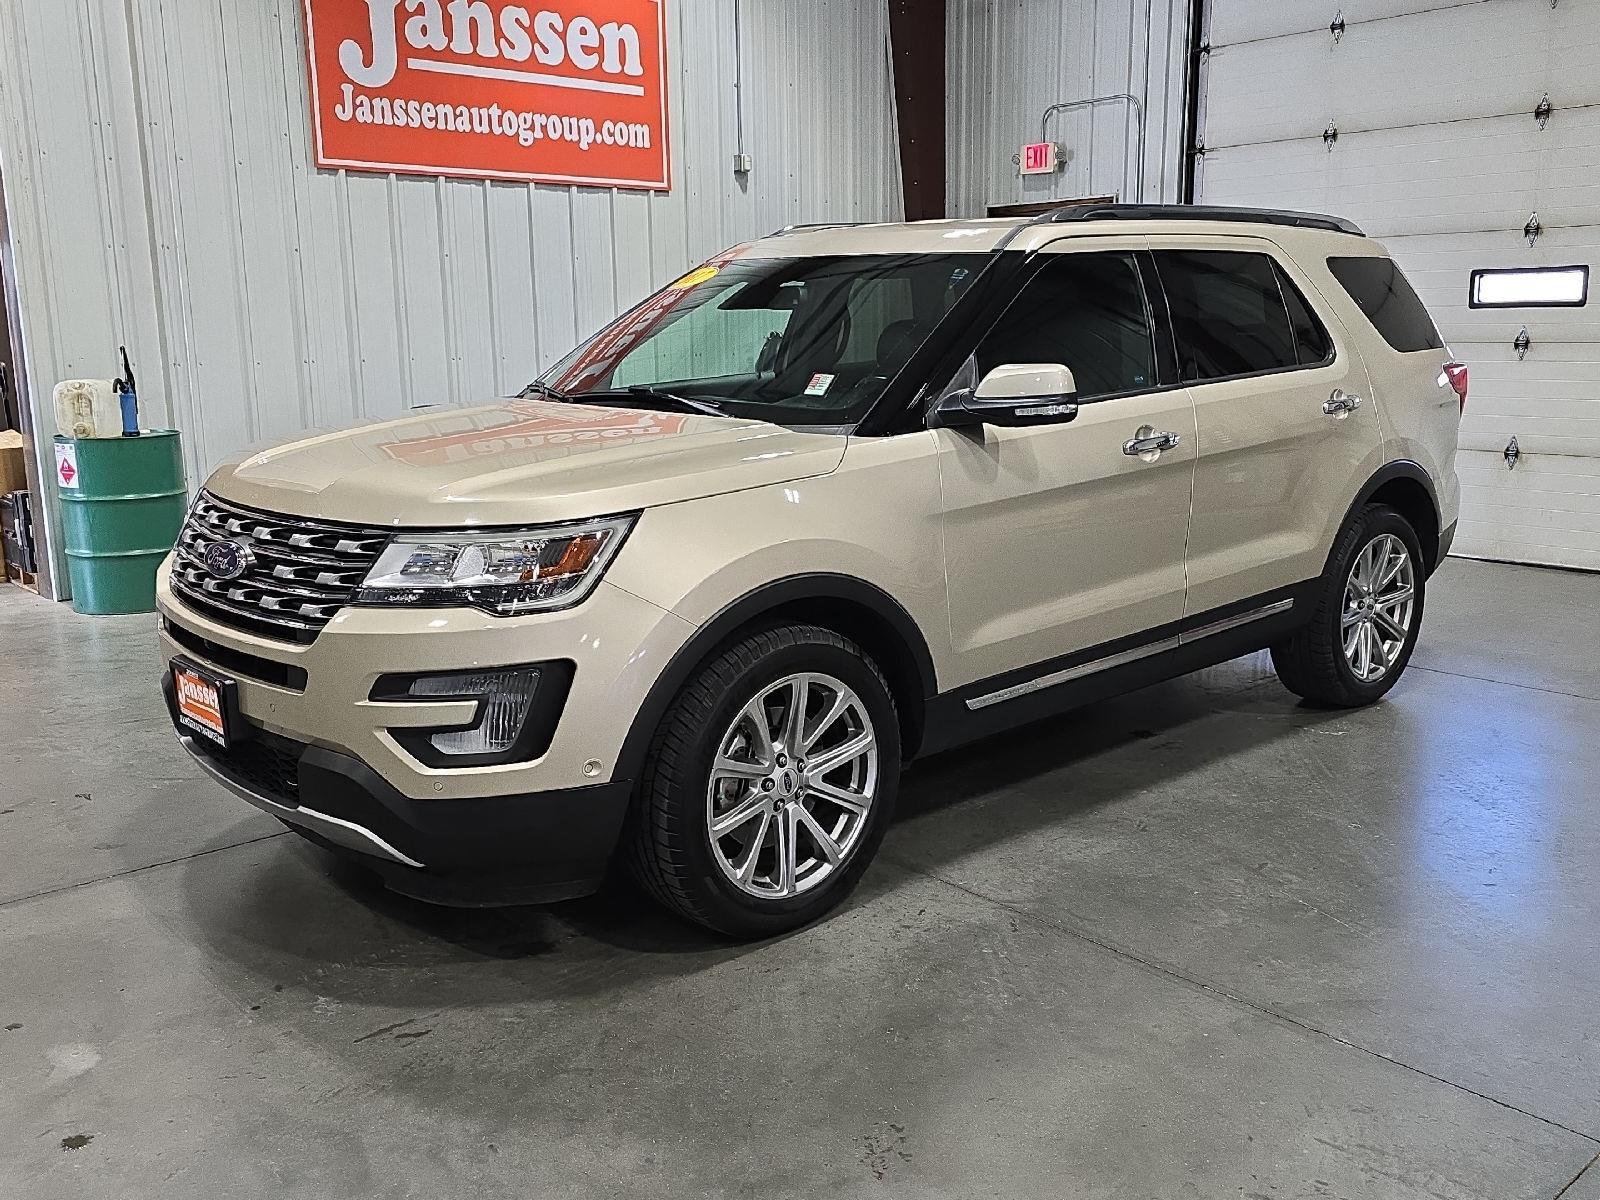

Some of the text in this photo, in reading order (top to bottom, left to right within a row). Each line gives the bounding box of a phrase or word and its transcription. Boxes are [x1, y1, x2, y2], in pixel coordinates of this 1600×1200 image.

[339, 0, 645, 88] Janssen
[335, 83, 651, 150] Janssenautogroup.com
[1026, 144, 1050, 169] EXIT
